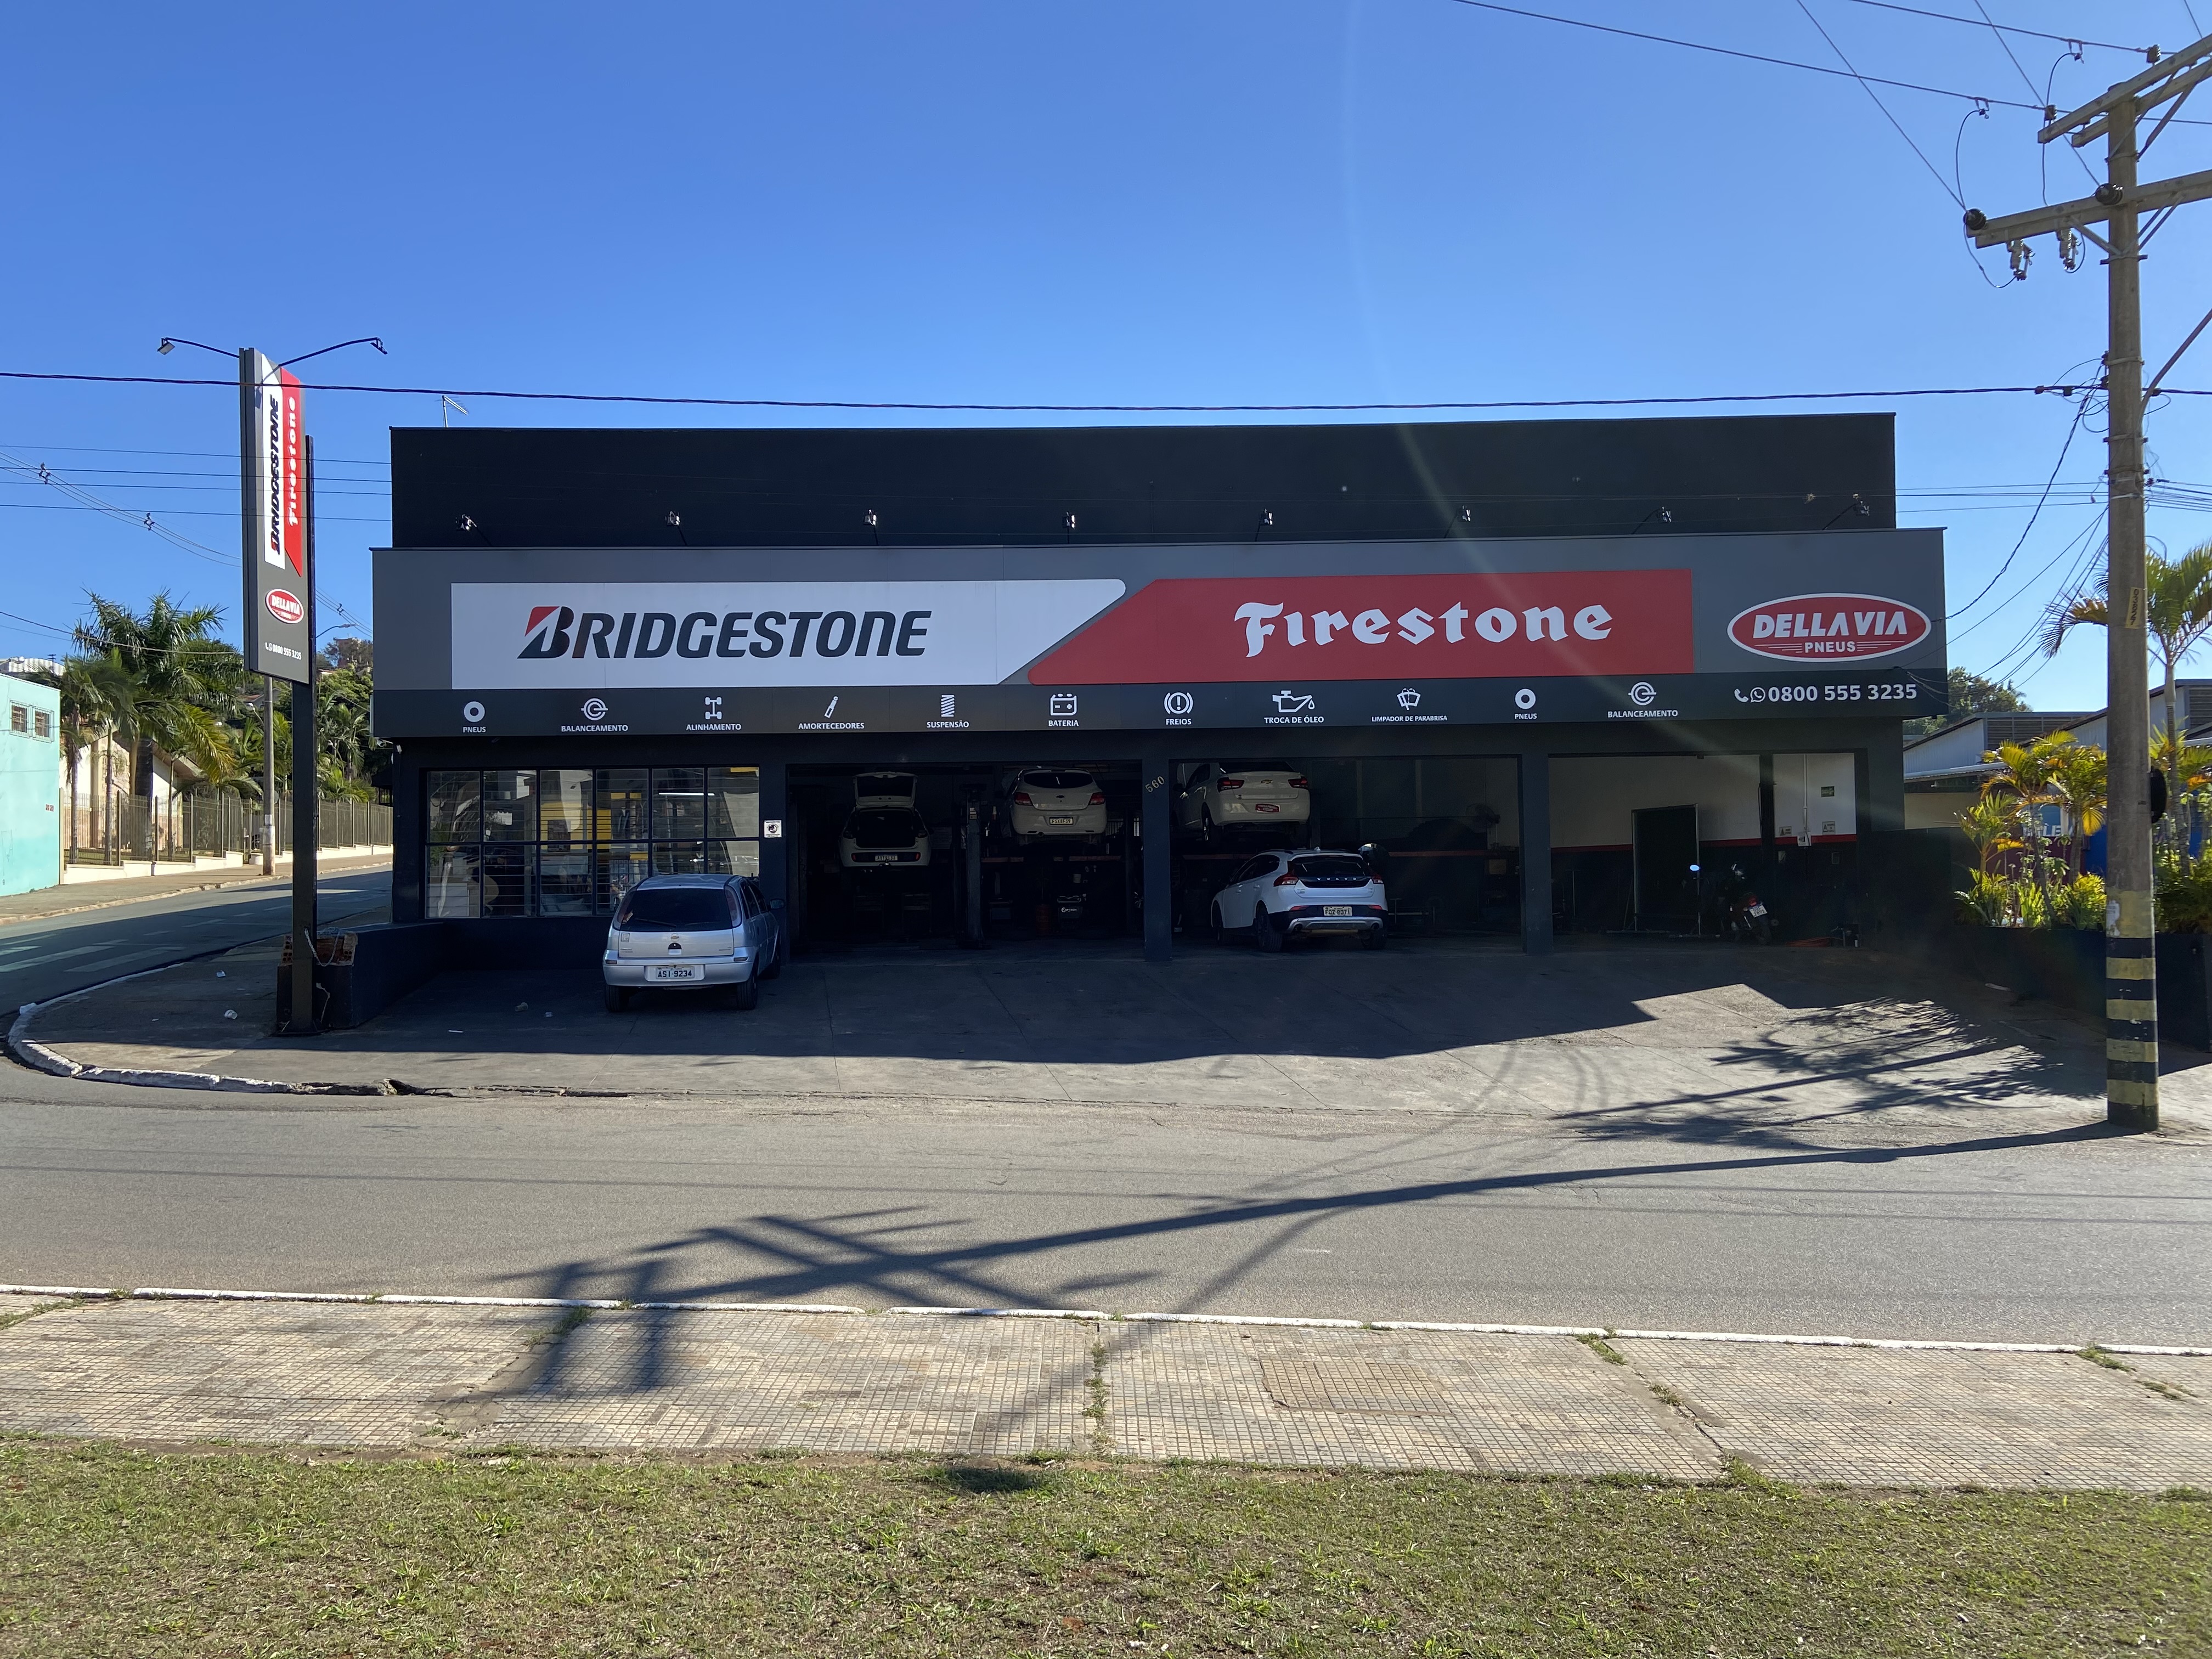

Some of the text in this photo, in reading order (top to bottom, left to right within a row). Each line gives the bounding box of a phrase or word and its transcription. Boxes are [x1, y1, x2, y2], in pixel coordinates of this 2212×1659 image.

[289, 397, 298, 526] Firestone
[270, 394, 280, 555] BRIDGESTONE
[517, 606, 932, 659] BRIDGESTONE
[1234, 602, 1612, 657] Firestone
[273, 644, 283, 654] 0800
[1805, 641, 1856, 653] PNEUS
[1768, 684, 1917, 702] 0800 555 3235
[1304, 715, 1324, 723] ÓLEO
[1607, 710, 1678, 718] BALANCEAMENTO
[926, 720, 969, 728] SUSPENSÃO
[1145, 776, 1165, 792] 560
